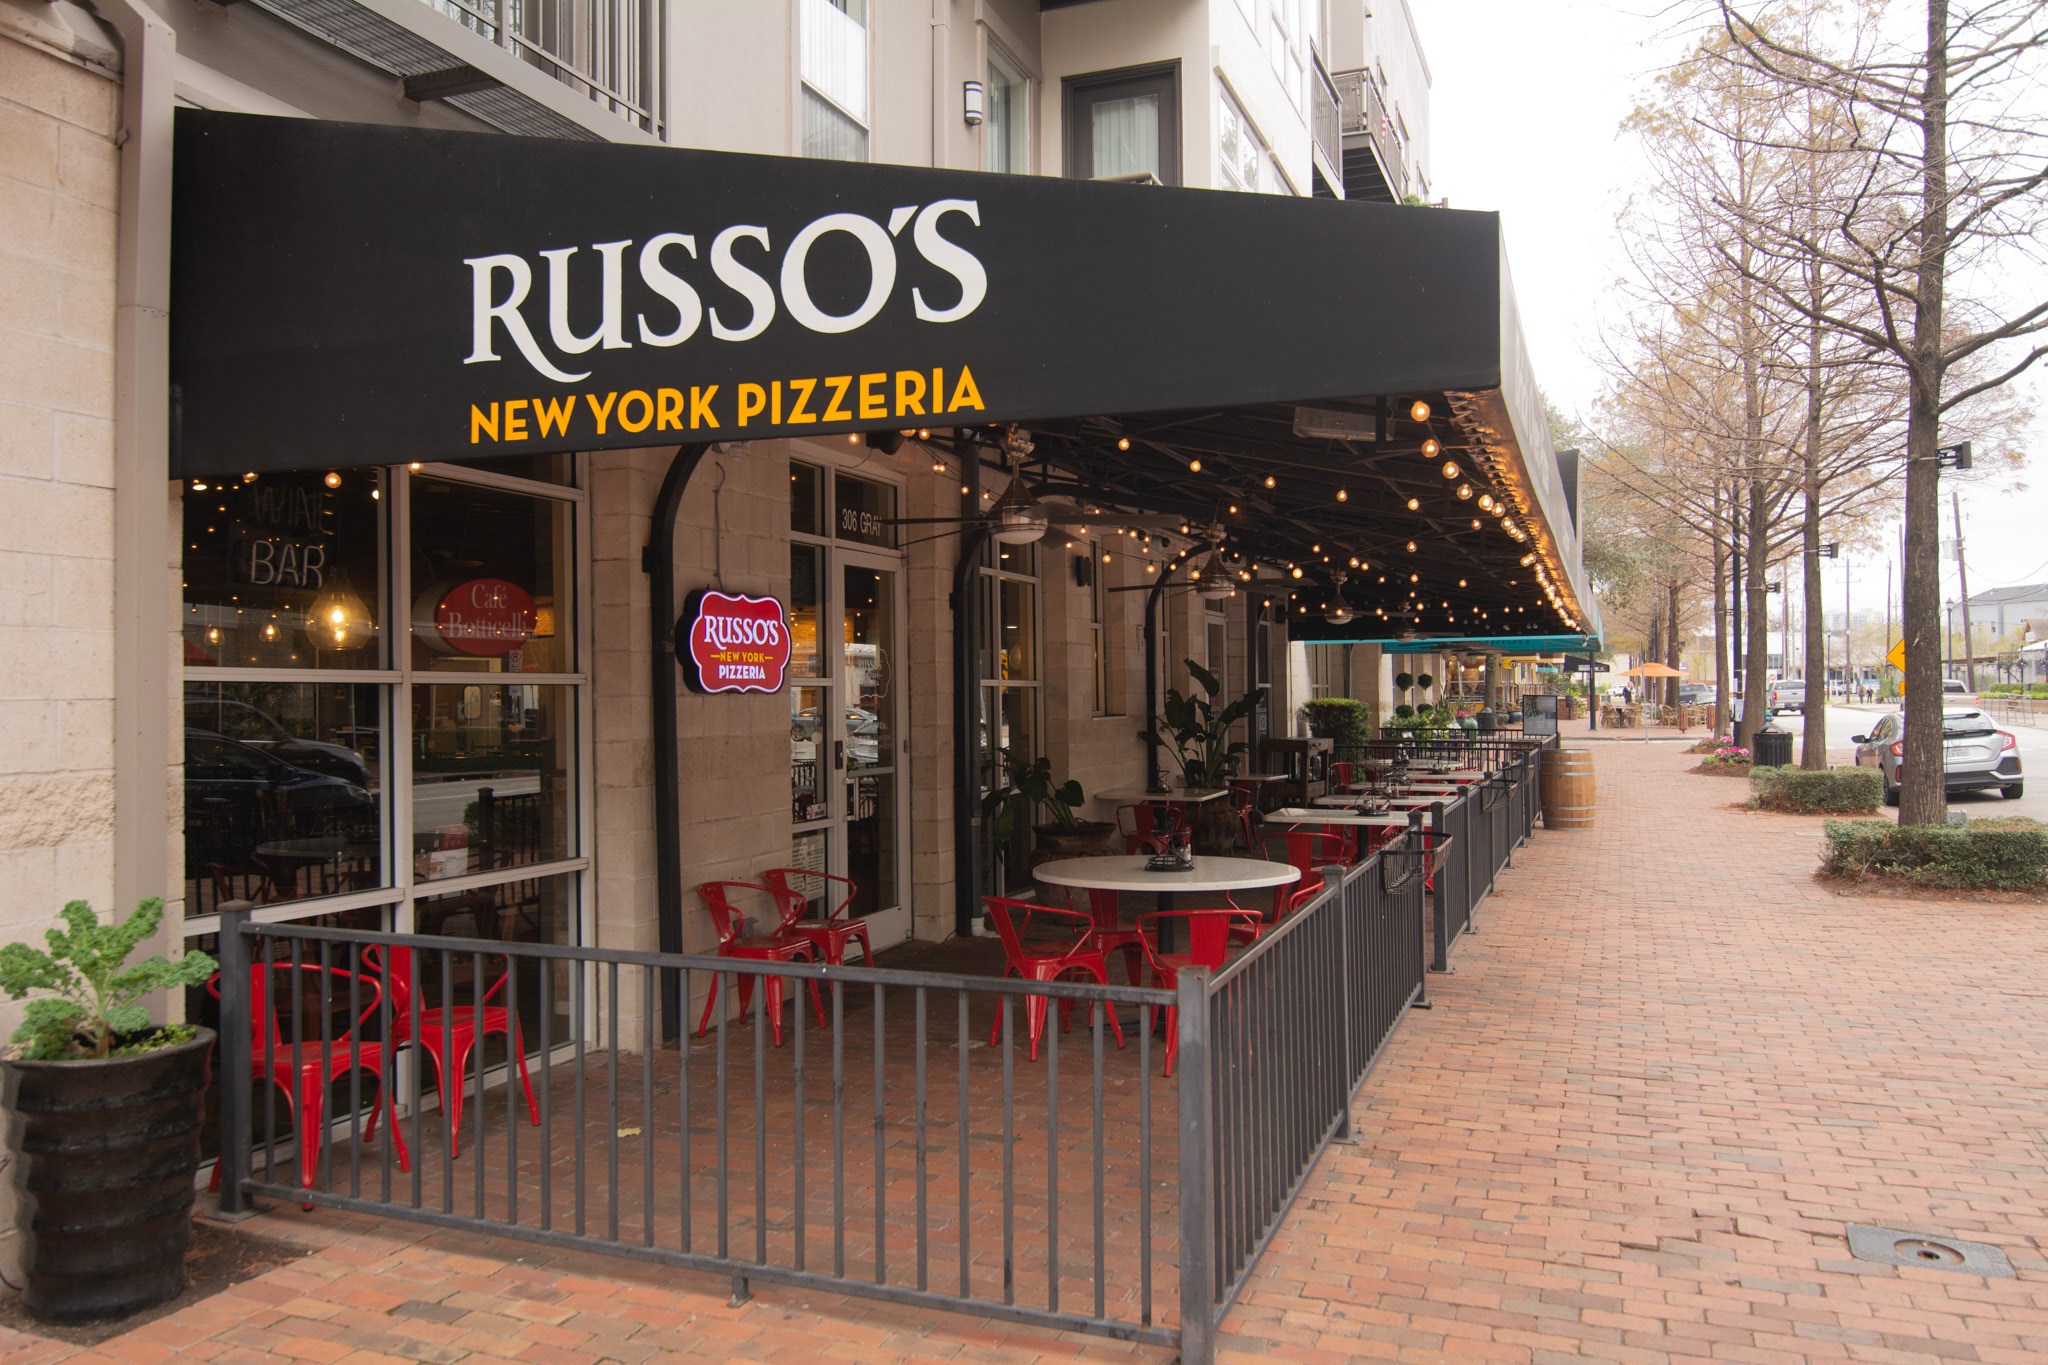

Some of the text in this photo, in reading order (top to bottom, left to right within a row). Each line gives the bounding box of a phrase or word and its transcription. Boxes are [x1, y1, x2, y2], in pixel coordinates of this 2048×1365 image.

[463, 199, 988, 383] RUSSO'S
[471, 365, 986, 444] NEW YORK PIZZERIA
[842, 508, 882, 536] 306 GRAY
[251, 540, 325, 588] BAR
[471, 583, 507, 609] Café
[448, 612, 527, 638] Botticelli
[703, 615, 779, 650] RUSSO'S
[720, 652, 765, 663] NEW YORK
[719, 665, 766, 679] PIZZERIA
